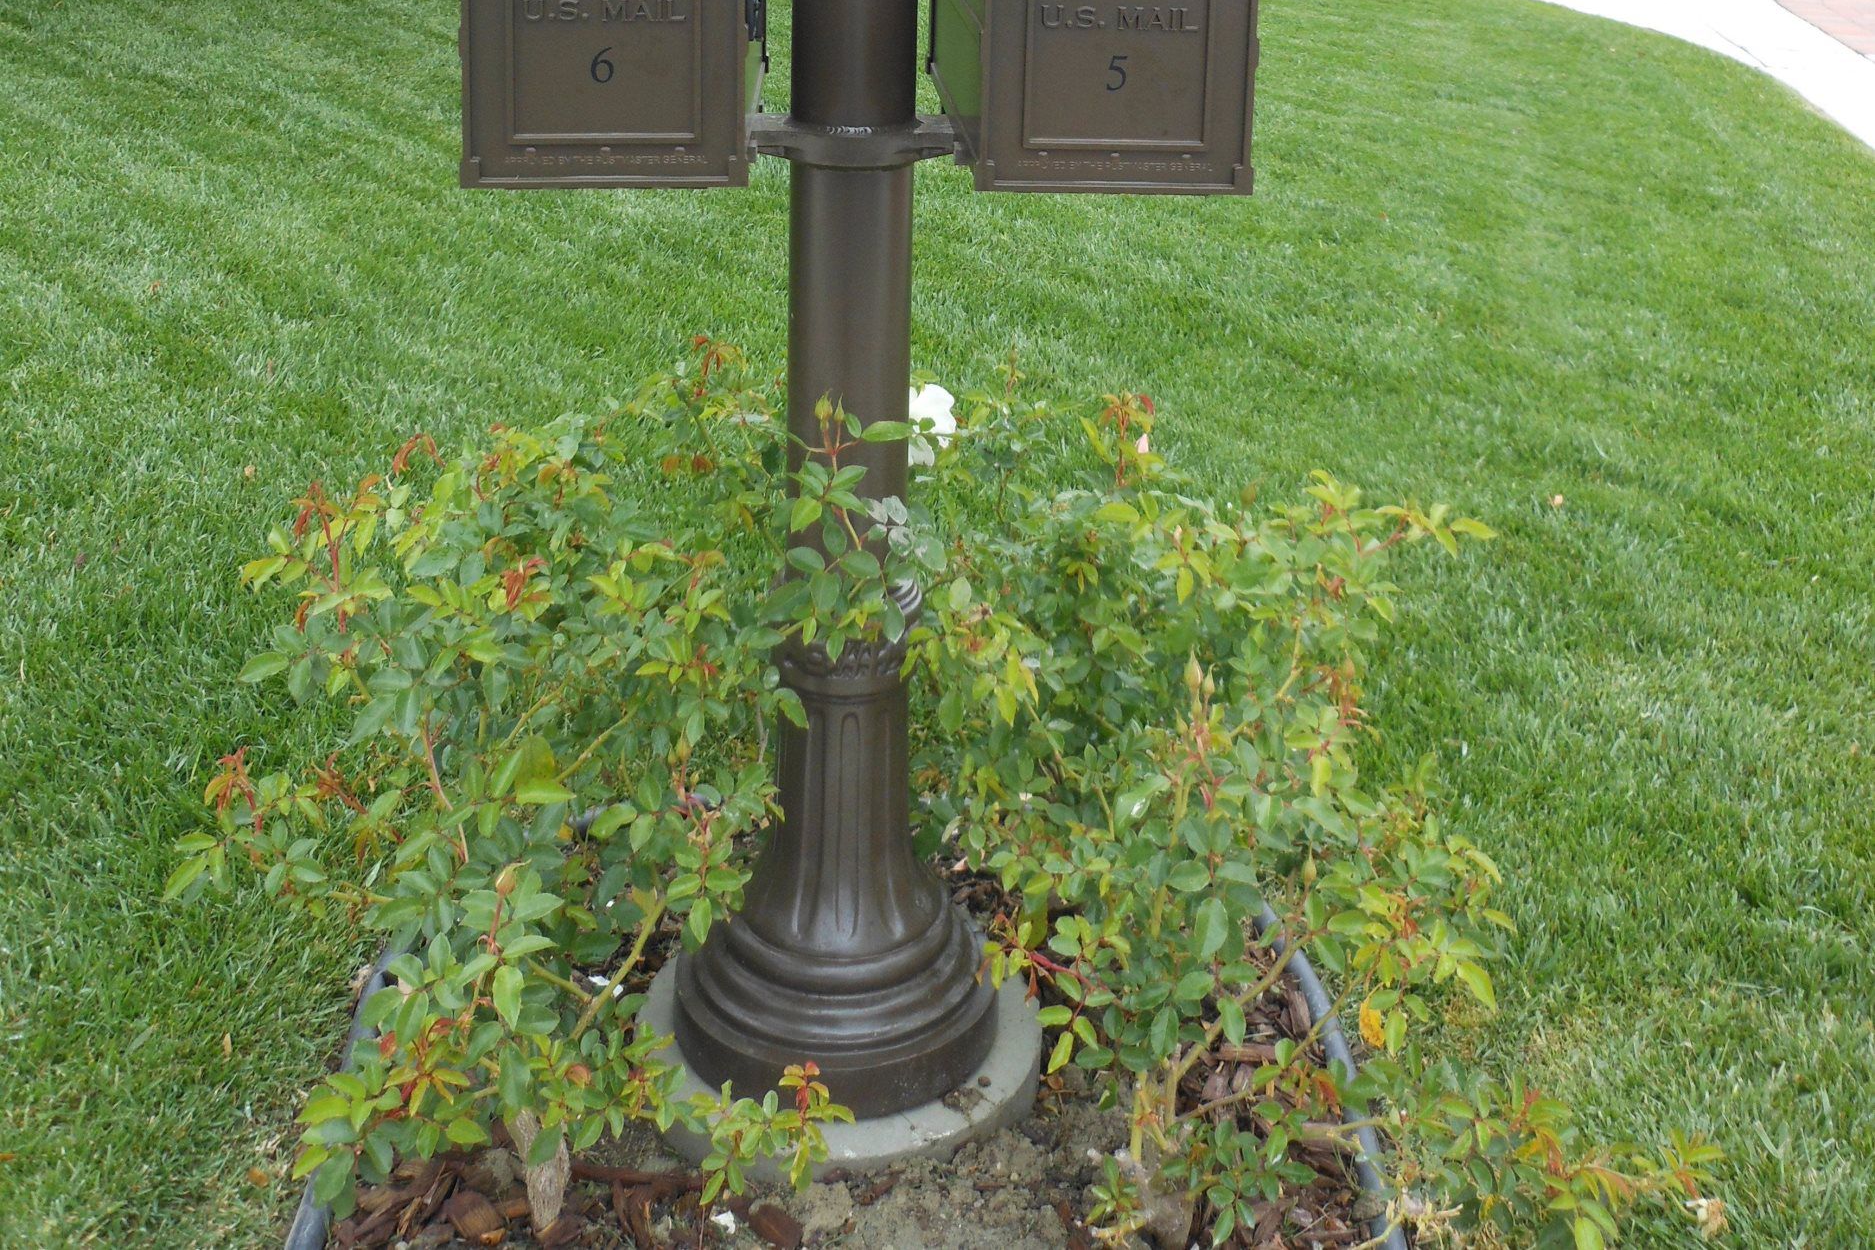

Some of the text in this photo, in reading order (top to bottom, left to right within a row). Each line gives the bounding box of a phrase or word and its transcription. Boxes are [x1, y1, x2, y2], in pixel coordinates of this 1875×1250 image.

[1040, 3, 1199, 33] U.S. MAIL
[590, 46, 615, 84] 6
[1106, 54, 1129, 91] 5
